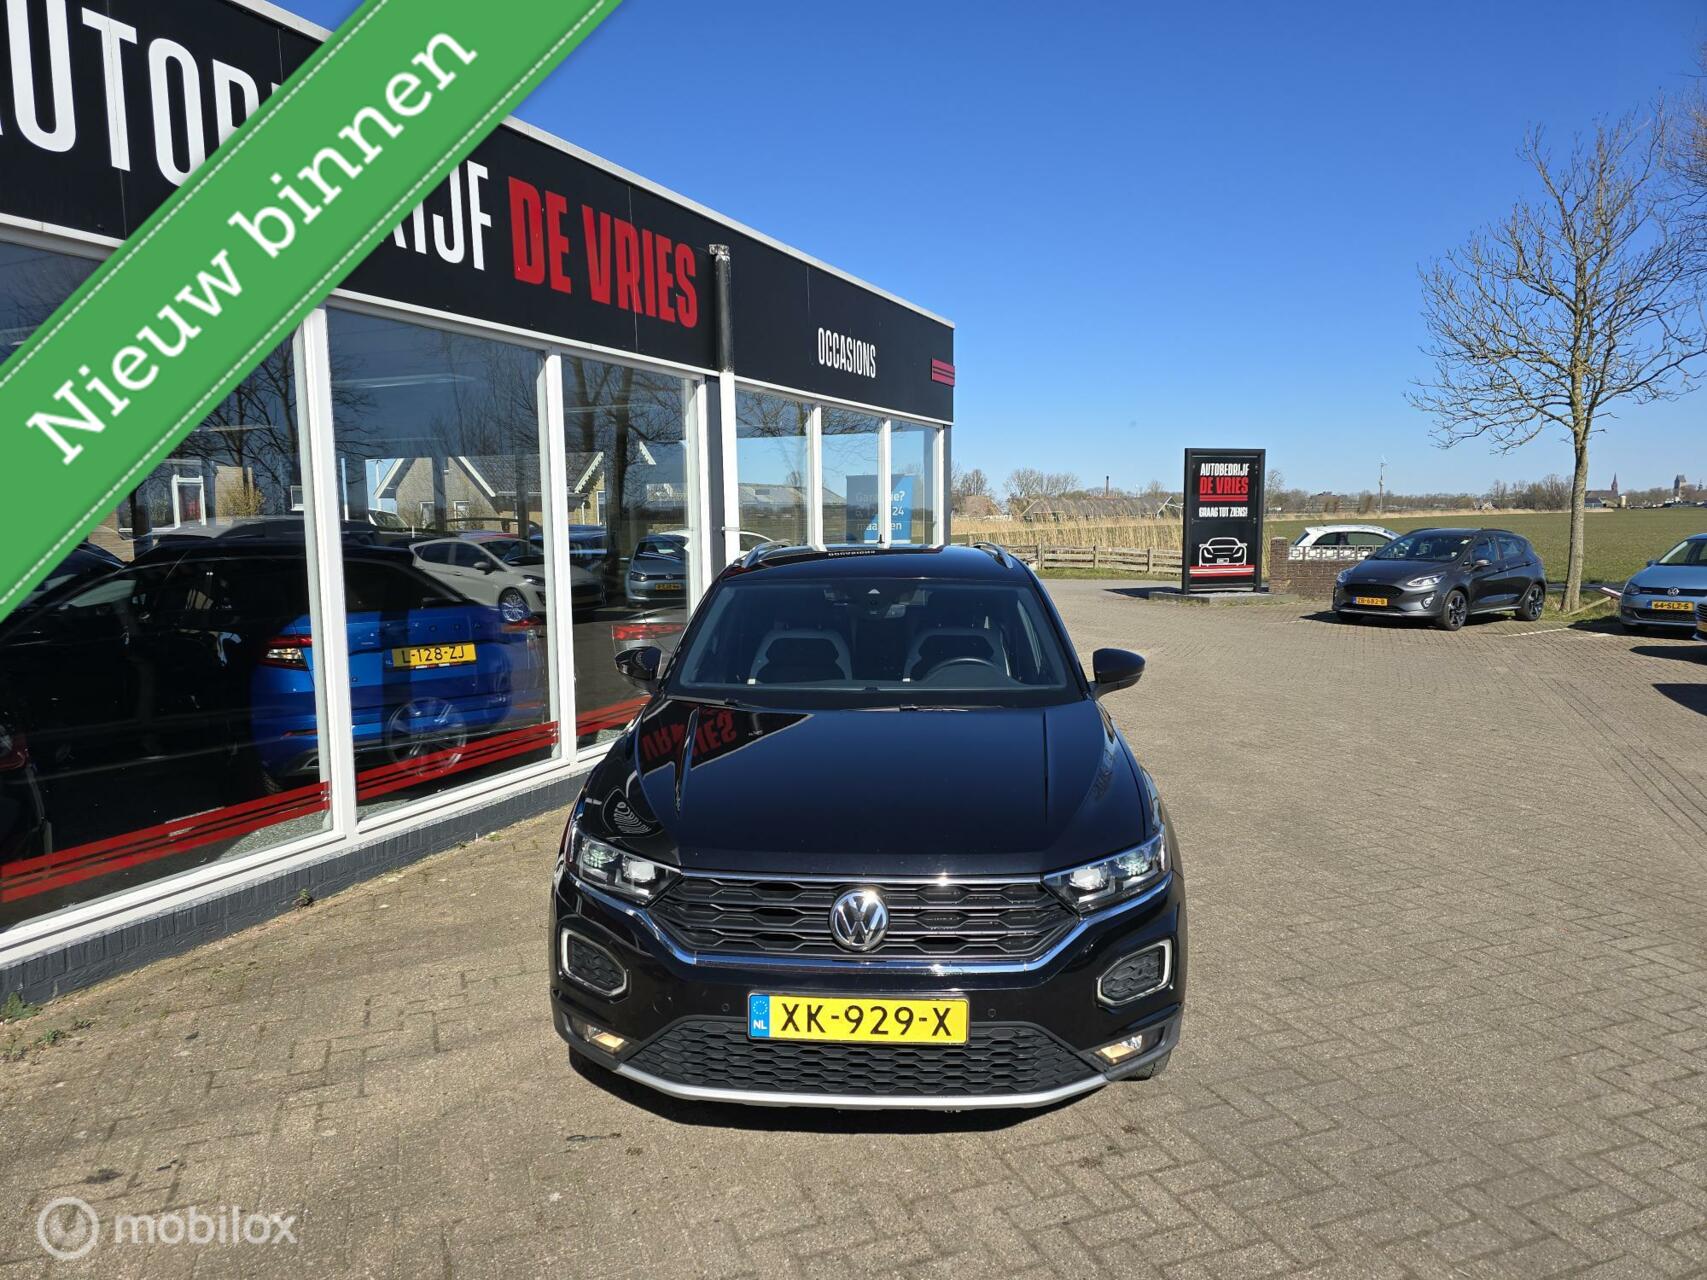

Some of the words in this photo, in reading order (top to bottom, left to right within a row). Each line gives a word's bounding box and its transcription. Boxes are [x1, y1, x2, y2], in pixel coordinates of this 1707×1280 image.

[508, 175, 572, 294] DE
[582, 204, 698, 328] VRIES
[817, 327, 876, 378] OCCASIONS
[1200, 462, 1250, 476] AUTOBEDRIJF
[1200, 477, 1213, 494] DE
[1216, 477, 1249, 494] VRIES
[892, 506, 905, 516] 24
[1219, 506, 1229, 517] TOT
[401, 645, 464, 663] L-128-ZJ
[753, 1019, 767, 1030] NL
[781, 1003, 952, 1037] XK-929-X
